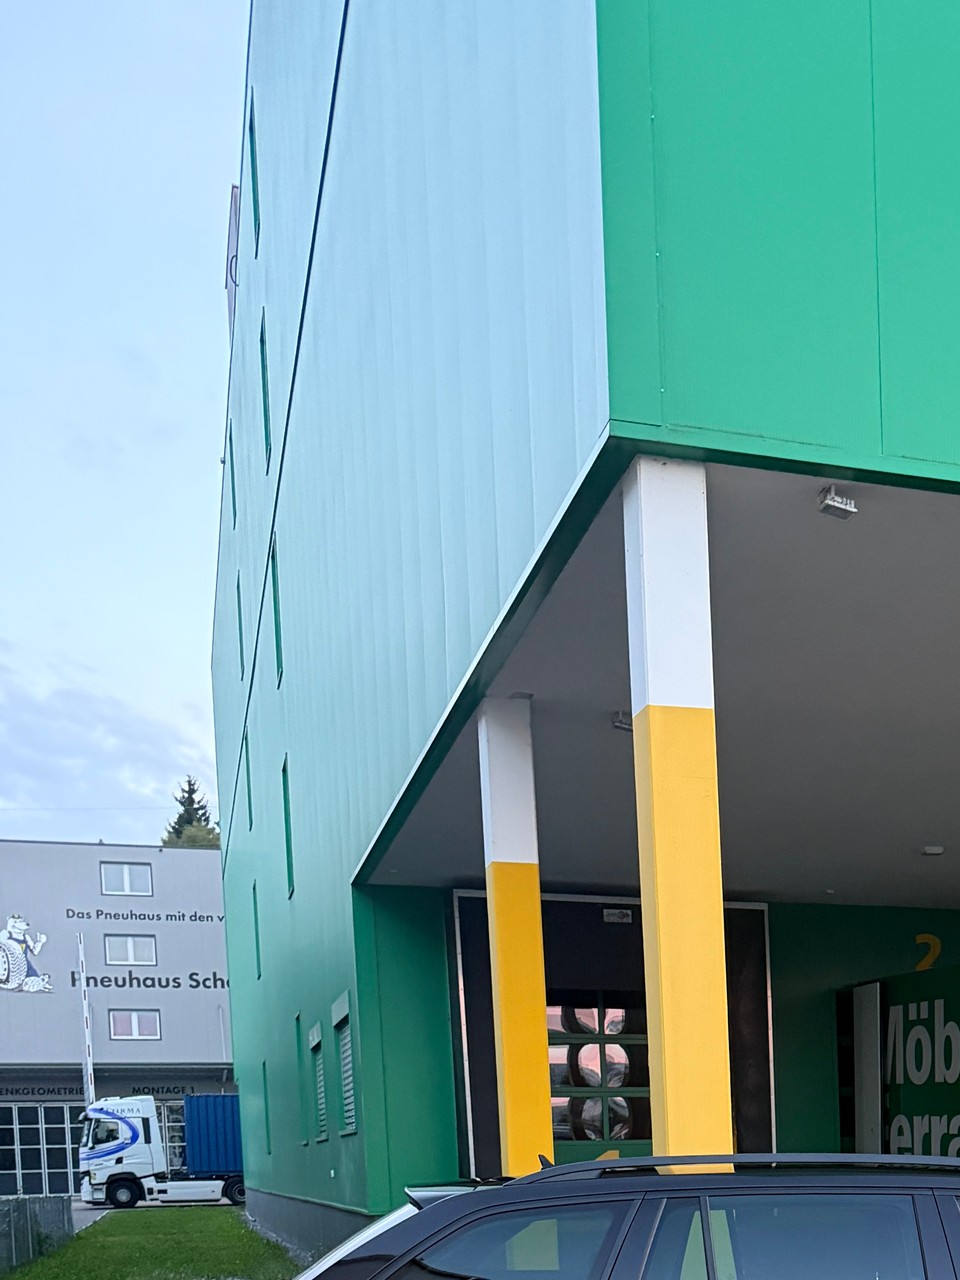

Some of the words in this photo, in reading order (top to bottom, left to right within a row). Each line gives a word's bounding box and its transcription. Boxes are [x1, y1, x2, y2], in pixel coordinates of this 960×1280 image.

[66, 908, 92, 920] Das
[96, 909, 162, 921] Pneuhaus
[165, 911, 186, 922] mit
[189, 911, 214, 922] den
[915, 933, 942, 971] 2
[188, 971, 230, 989] Sch
[132, 1086, 187, 1095] MONTAGE
